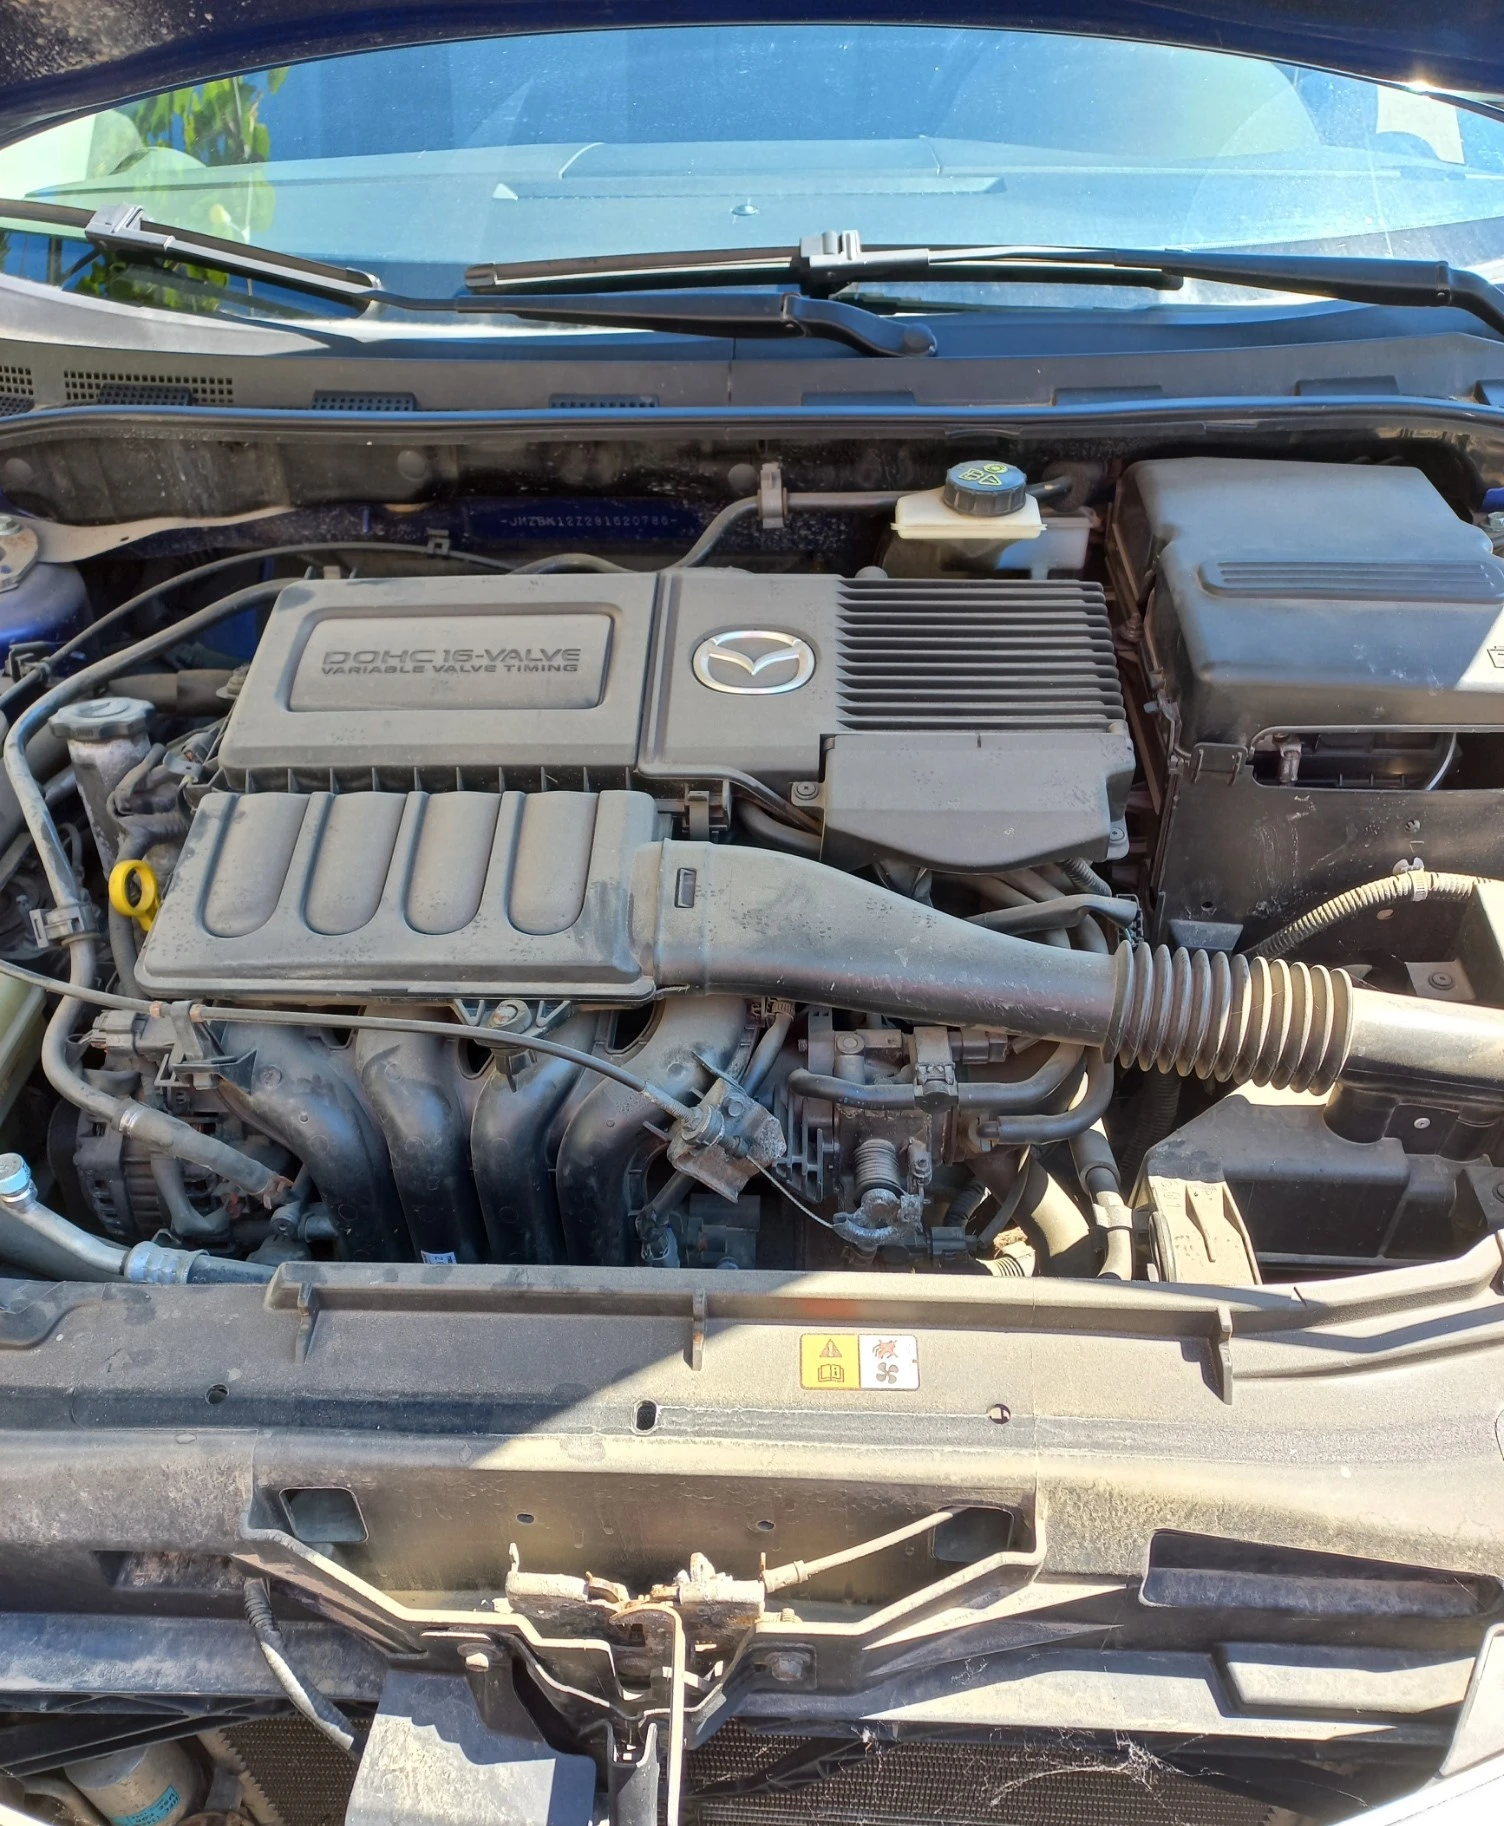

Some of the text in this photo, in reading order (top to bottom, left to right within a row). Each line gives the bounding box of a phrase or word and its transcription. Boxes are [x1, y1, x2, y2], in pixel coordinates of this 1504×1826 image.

[323, 649, 582, 665] DOHC 16-VALVE
[321, 663, 579, 675] VARIABLE VALVE TIMING
